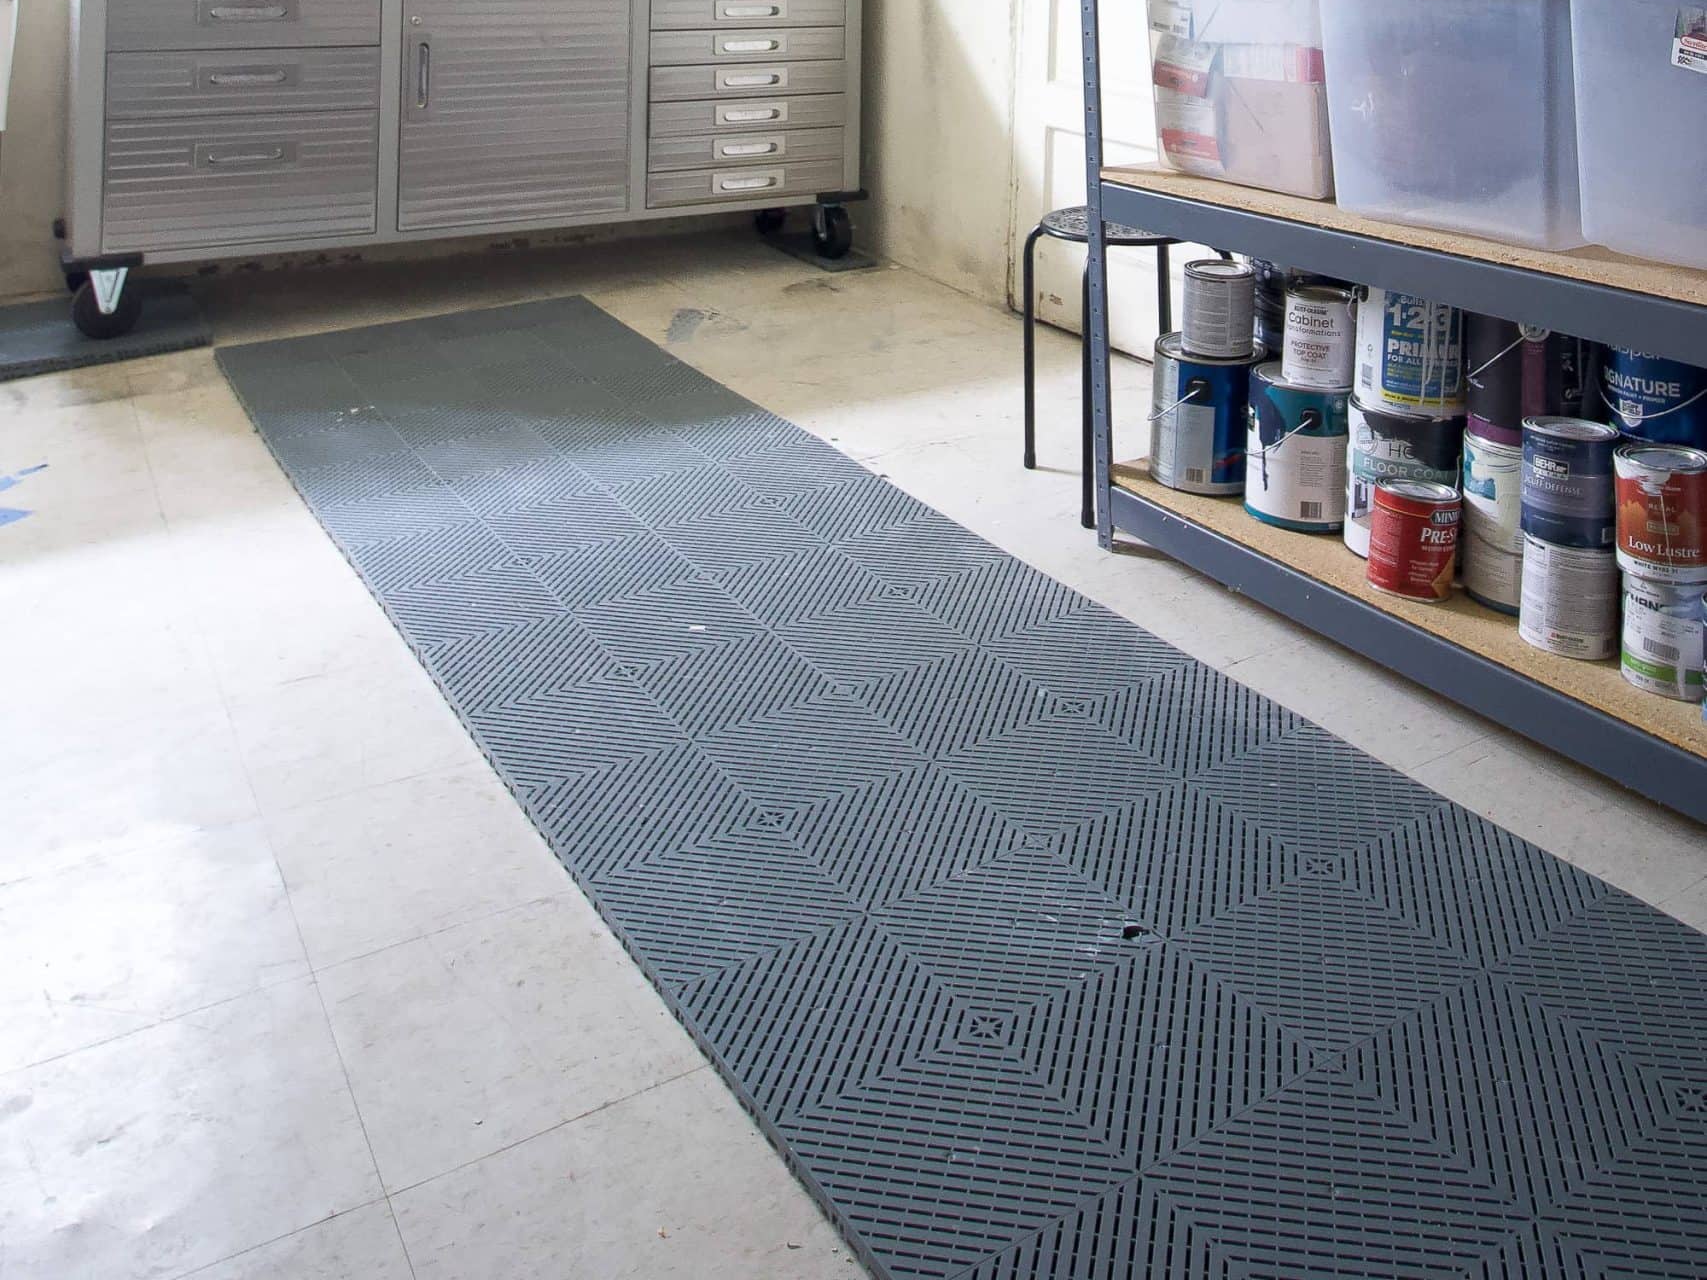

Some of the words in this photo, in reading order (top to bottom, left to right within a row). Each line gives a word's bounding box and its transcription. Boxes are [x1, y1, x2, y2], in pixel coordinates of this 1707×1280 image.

[1289, 311, 1334, 329] Cabinet
[1389, 304, 1450, 332] 1-23
[1307, 351, 1328, 360] COAT
[1387, 353, 1403, 364] FOR
[1407, 355, 1421, 366] ALL
[1363, 457, 1408, 477] FLOOR
[1420, 527, 1456, 544] PRE-S
[1628, 535, 1655, 553] Low
[1657, 543, 1700, 558] Lustre
